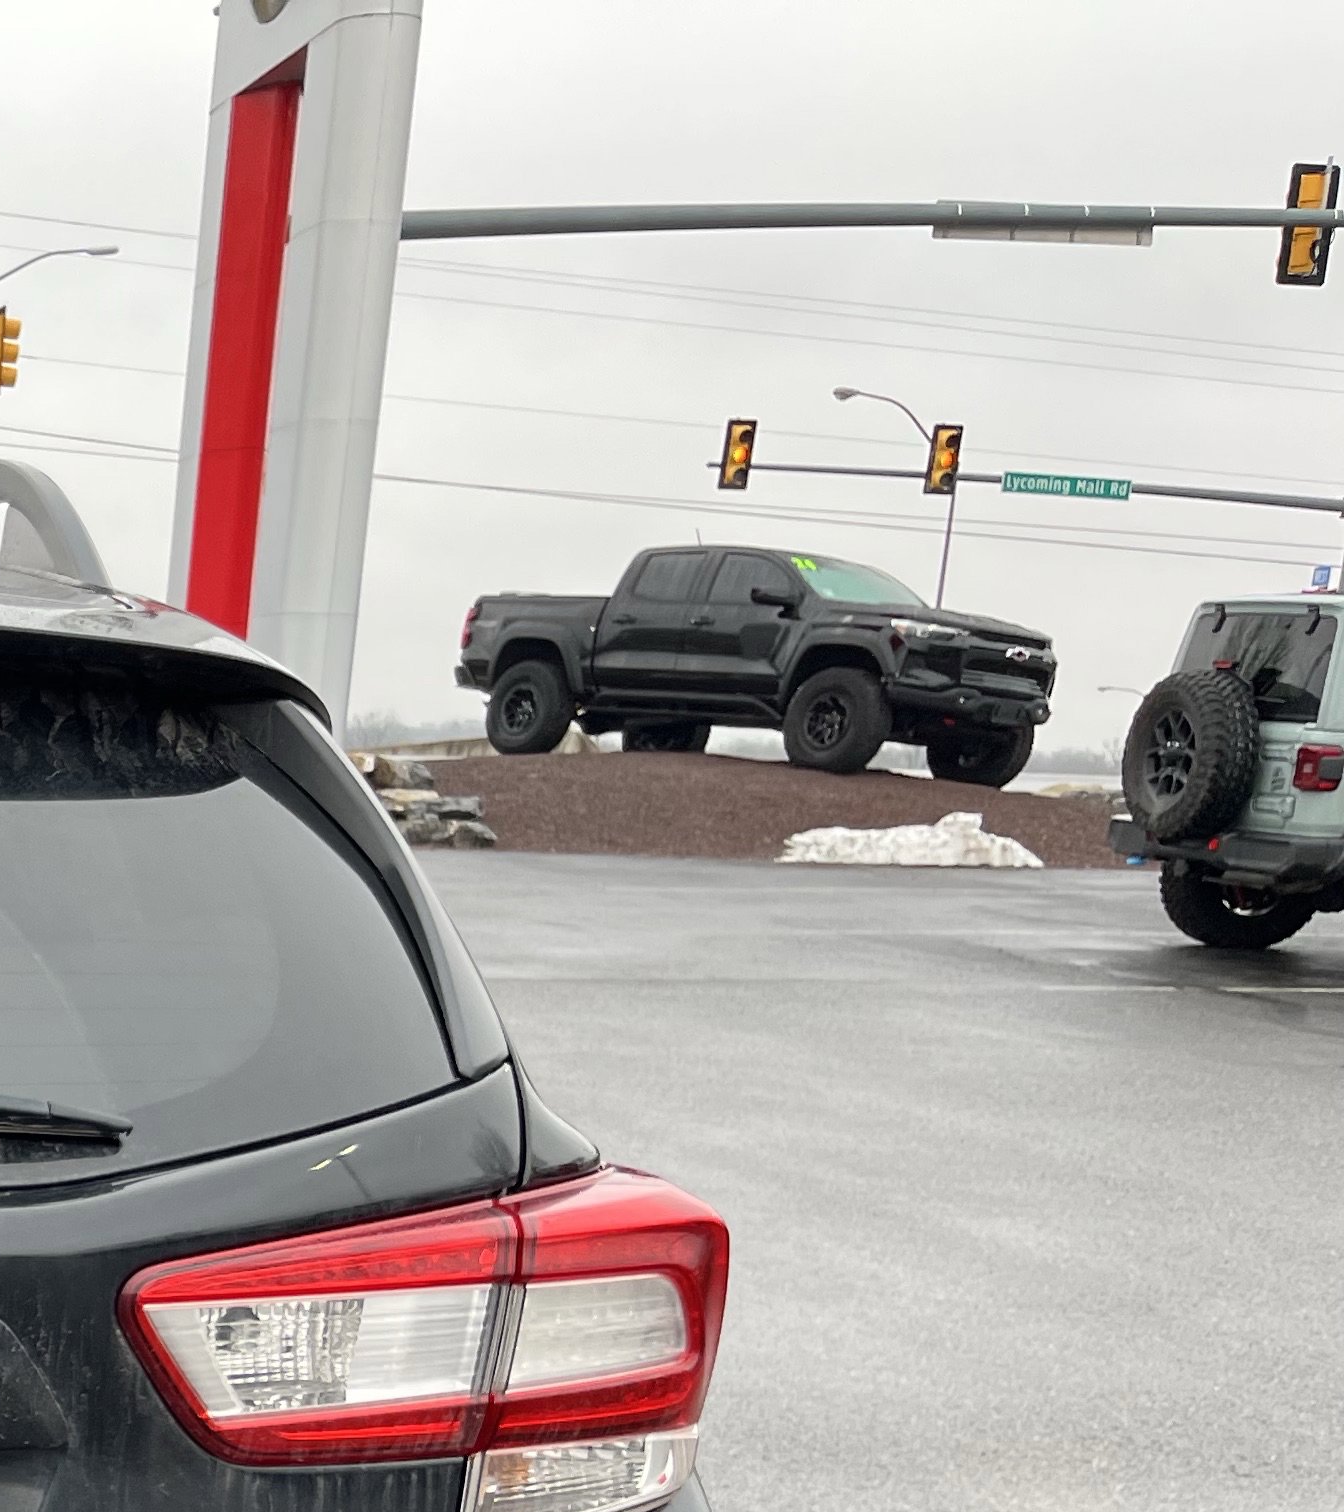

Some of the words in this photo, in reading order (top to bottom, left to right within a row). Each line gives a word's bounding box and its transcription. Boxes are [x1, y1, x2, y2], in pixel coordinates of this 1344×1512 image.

[1006, 474, 1070, 495] Lycoming
[1076, 479, 1104, 495] Mall
[1109, 481, 1128, 496] Rd
